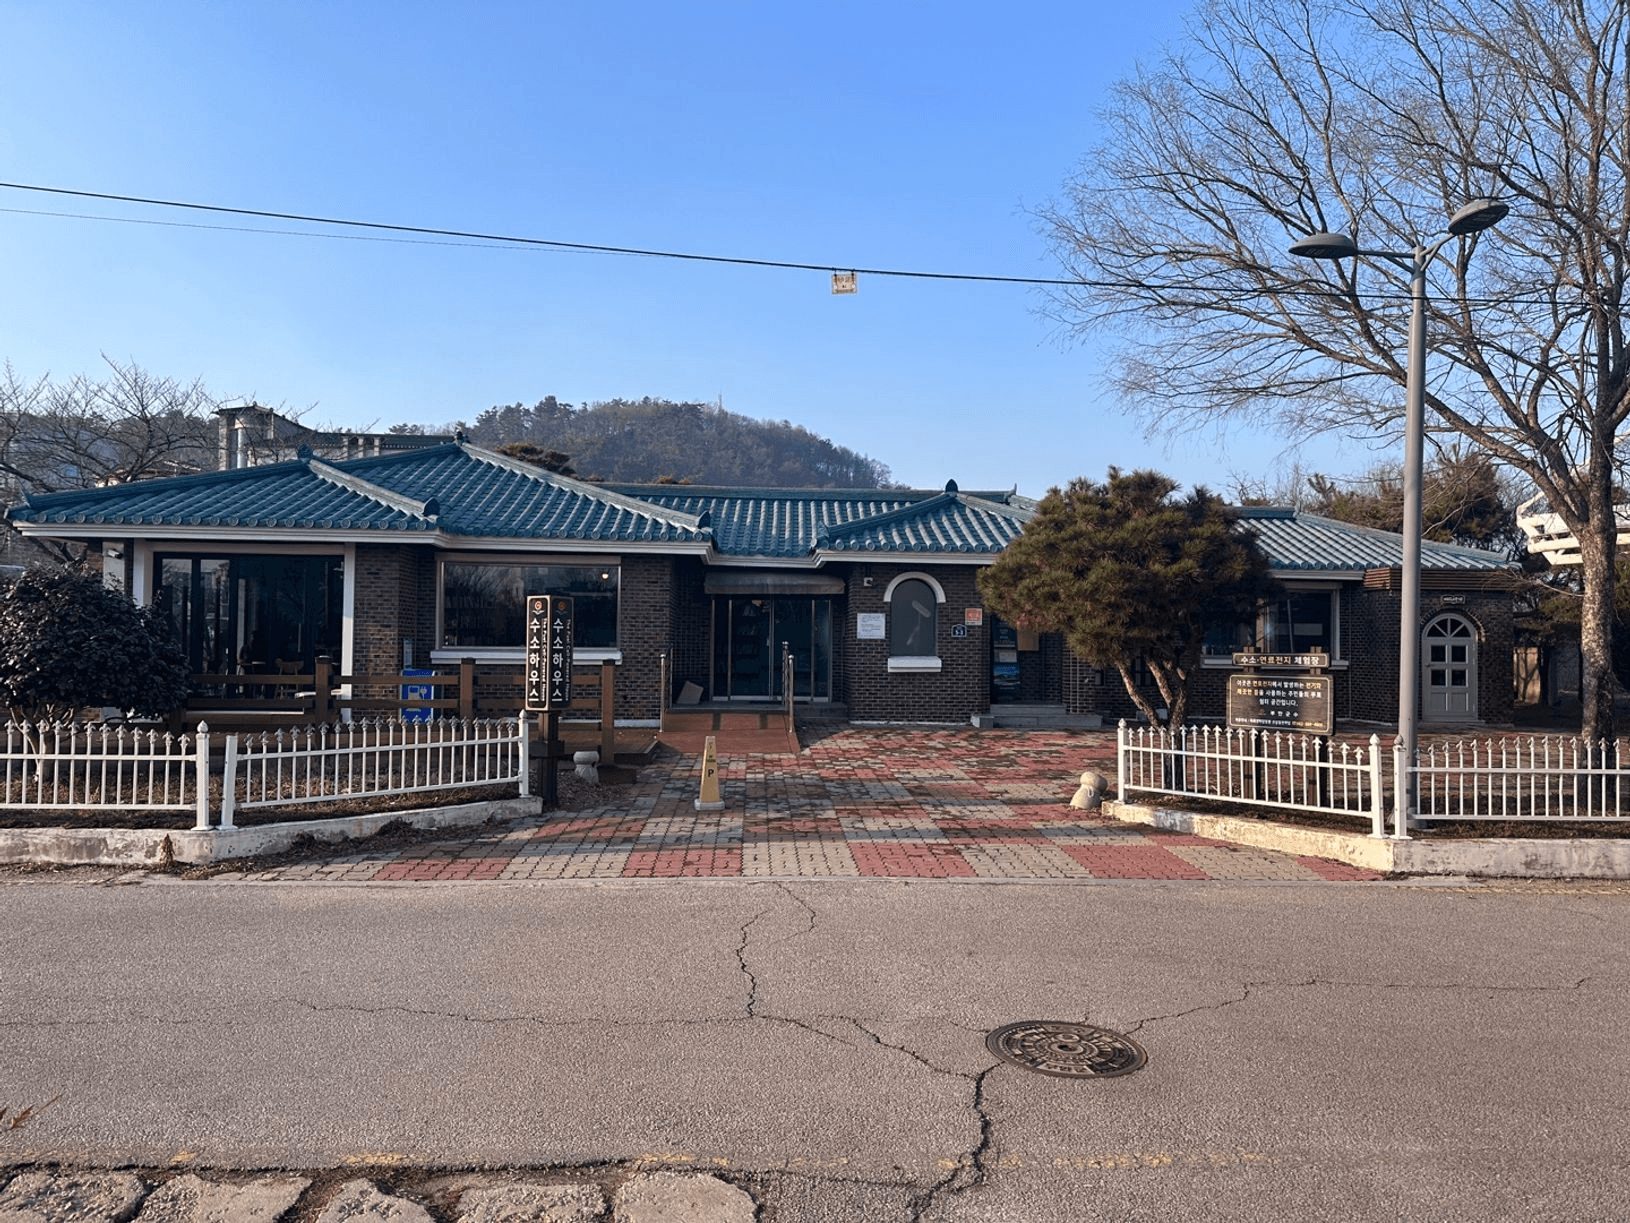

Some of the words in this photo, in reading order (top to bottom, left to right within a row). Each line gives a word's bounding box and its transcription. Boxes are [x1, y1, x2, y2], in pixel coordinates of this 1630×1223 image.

[528, 618, 540, 702] 수소하우스
[551, 618, 564, 702] 수소하우스
[1293, 656, 1319, 666] 체험장
[708, 769, 714, 777] P
